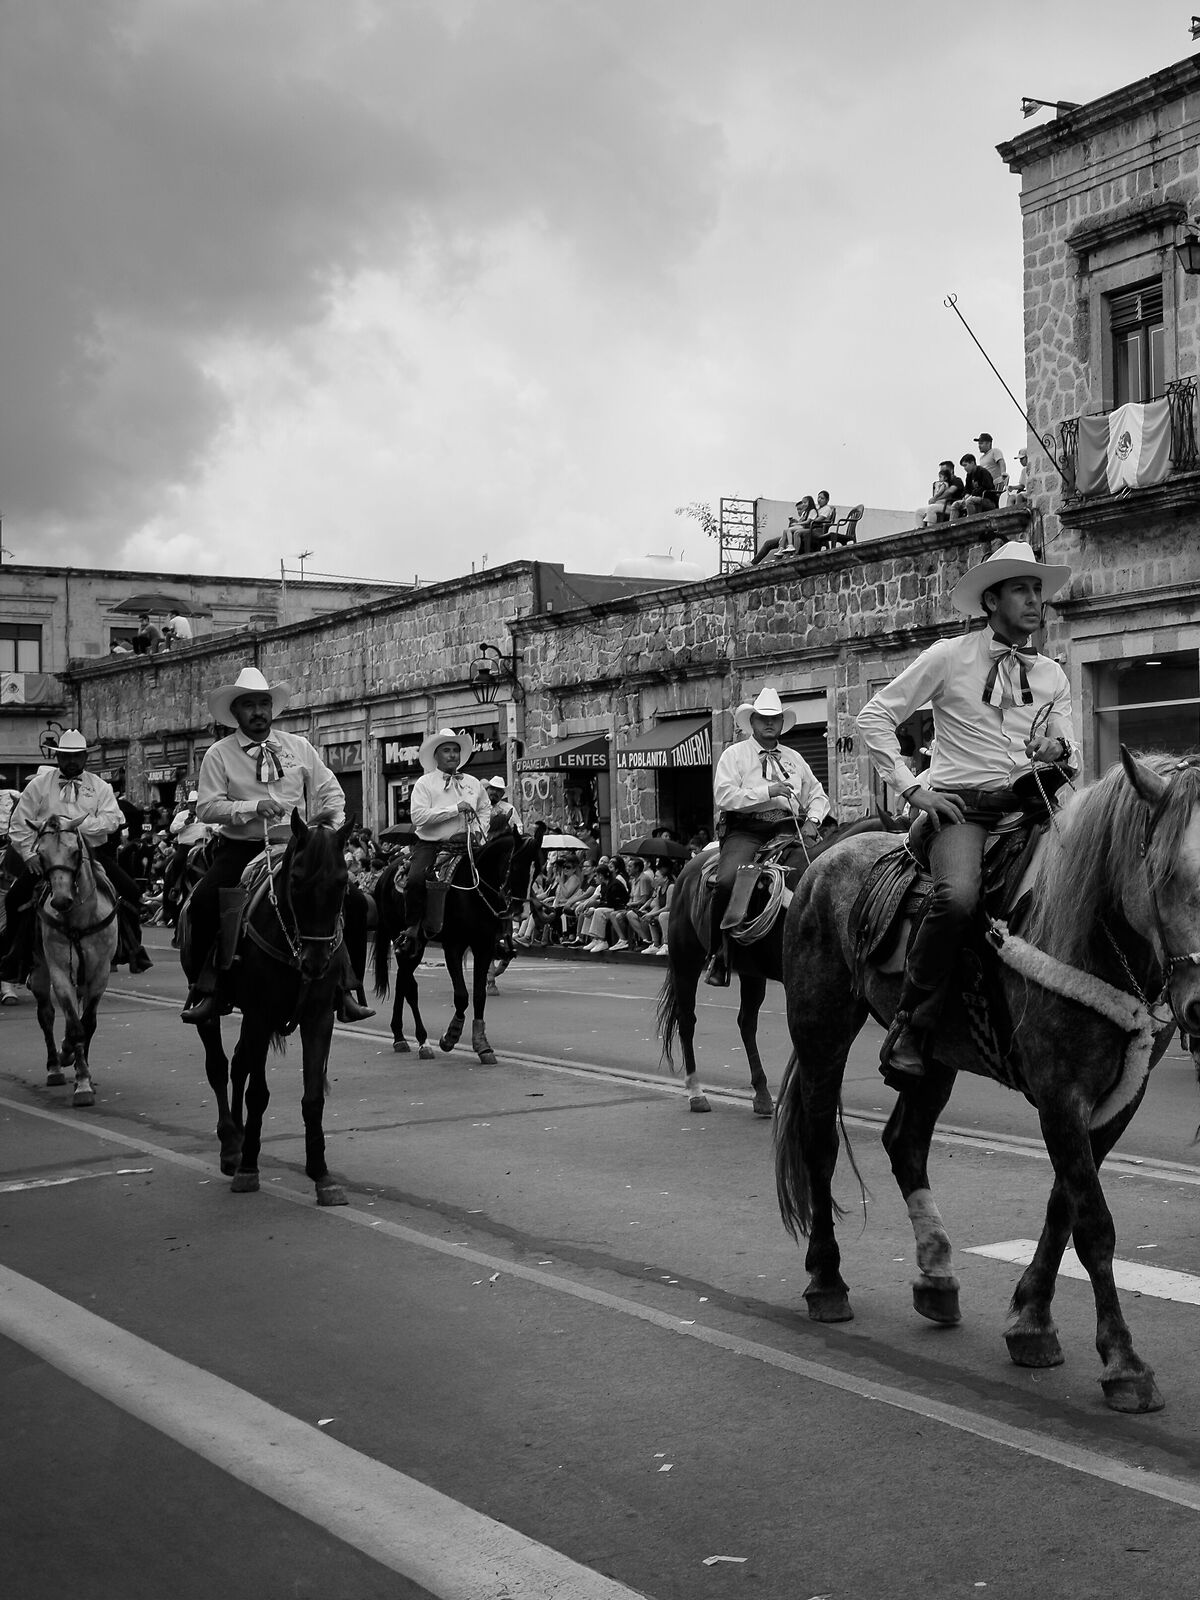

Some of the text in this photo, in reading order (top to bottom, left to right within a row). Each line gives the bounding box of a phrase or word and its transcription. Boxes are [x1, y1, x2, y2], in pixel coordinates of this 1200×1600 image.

[522, 758, 550, 771] PAMELA
[559, 754, 607, 766] LENTES
[617, 751, 668, 768] LA POBLANITA
